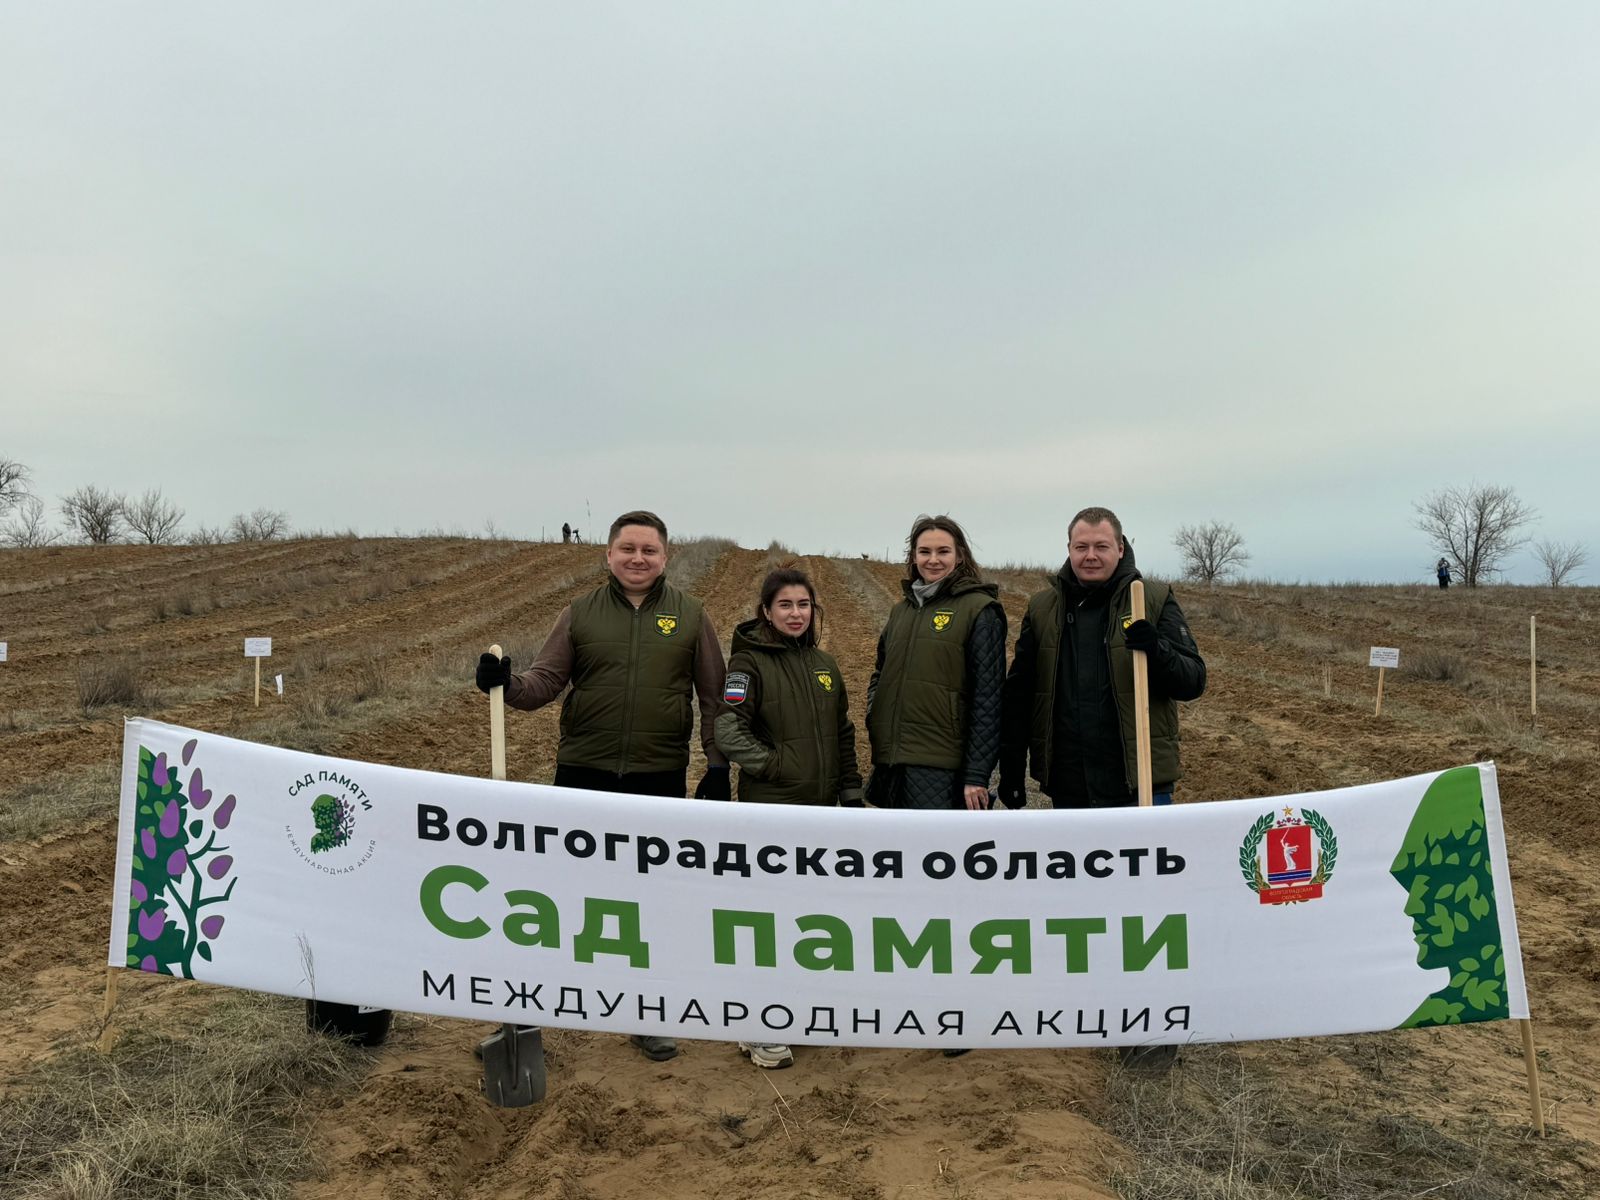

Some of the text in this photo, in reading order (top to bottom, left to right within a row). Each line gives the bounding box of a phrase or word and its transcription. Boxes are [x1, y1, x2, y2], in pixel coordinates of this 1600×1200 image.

[288, 770, 373, 811] САД ПАМЯТИ
[285, 825, 377, 875] МЕЖДУНАРОДНАЯ АКЦИЯ
[417, 803, 1186, 881] Волгоградская область
[419, 864, 1189, 976] Сад памяти
[422, 969, 1191, 1040] МЕЖДУНАРОДНАЯ АКЦИЯ
